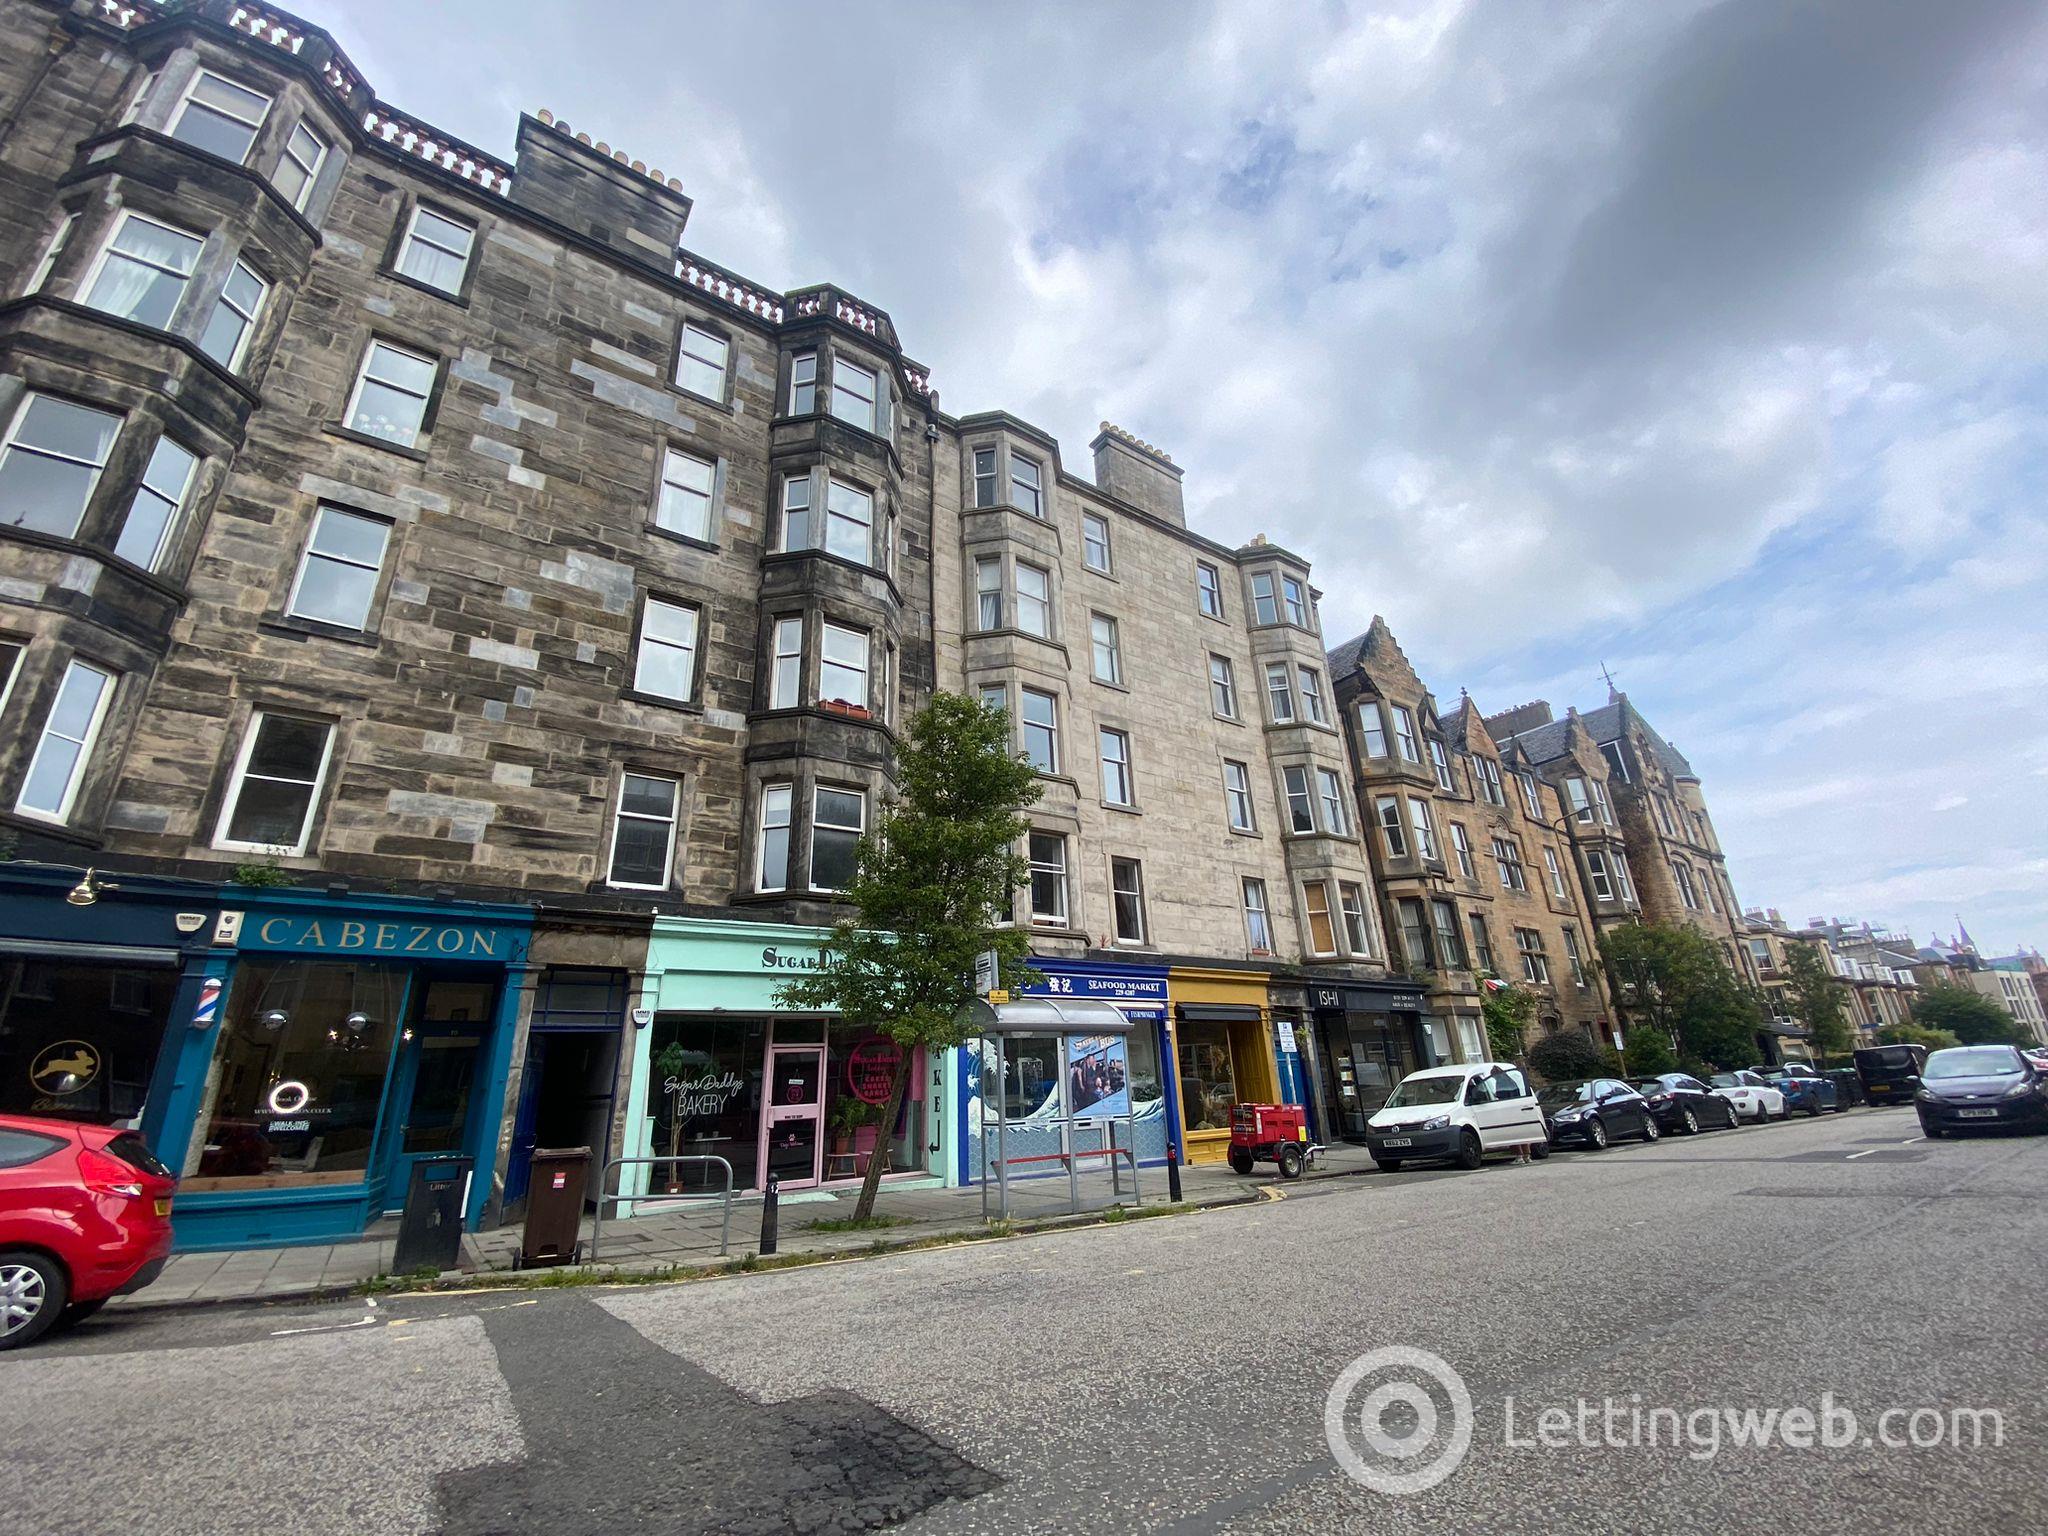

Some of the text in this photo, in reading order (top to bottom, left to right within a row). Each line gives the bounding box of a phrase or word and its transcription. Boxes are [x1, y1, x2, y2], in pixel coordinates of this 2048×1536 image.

[260, 918, 496, 955] CABEZON
[1088, 980, 1160, 992] SEAFOOD MARKET
[1318, 990, 1339, 1006] ISHI
[664, 1075, 700, 1096] Sugar
[677, 1094, 728, 1116] BAKERY
